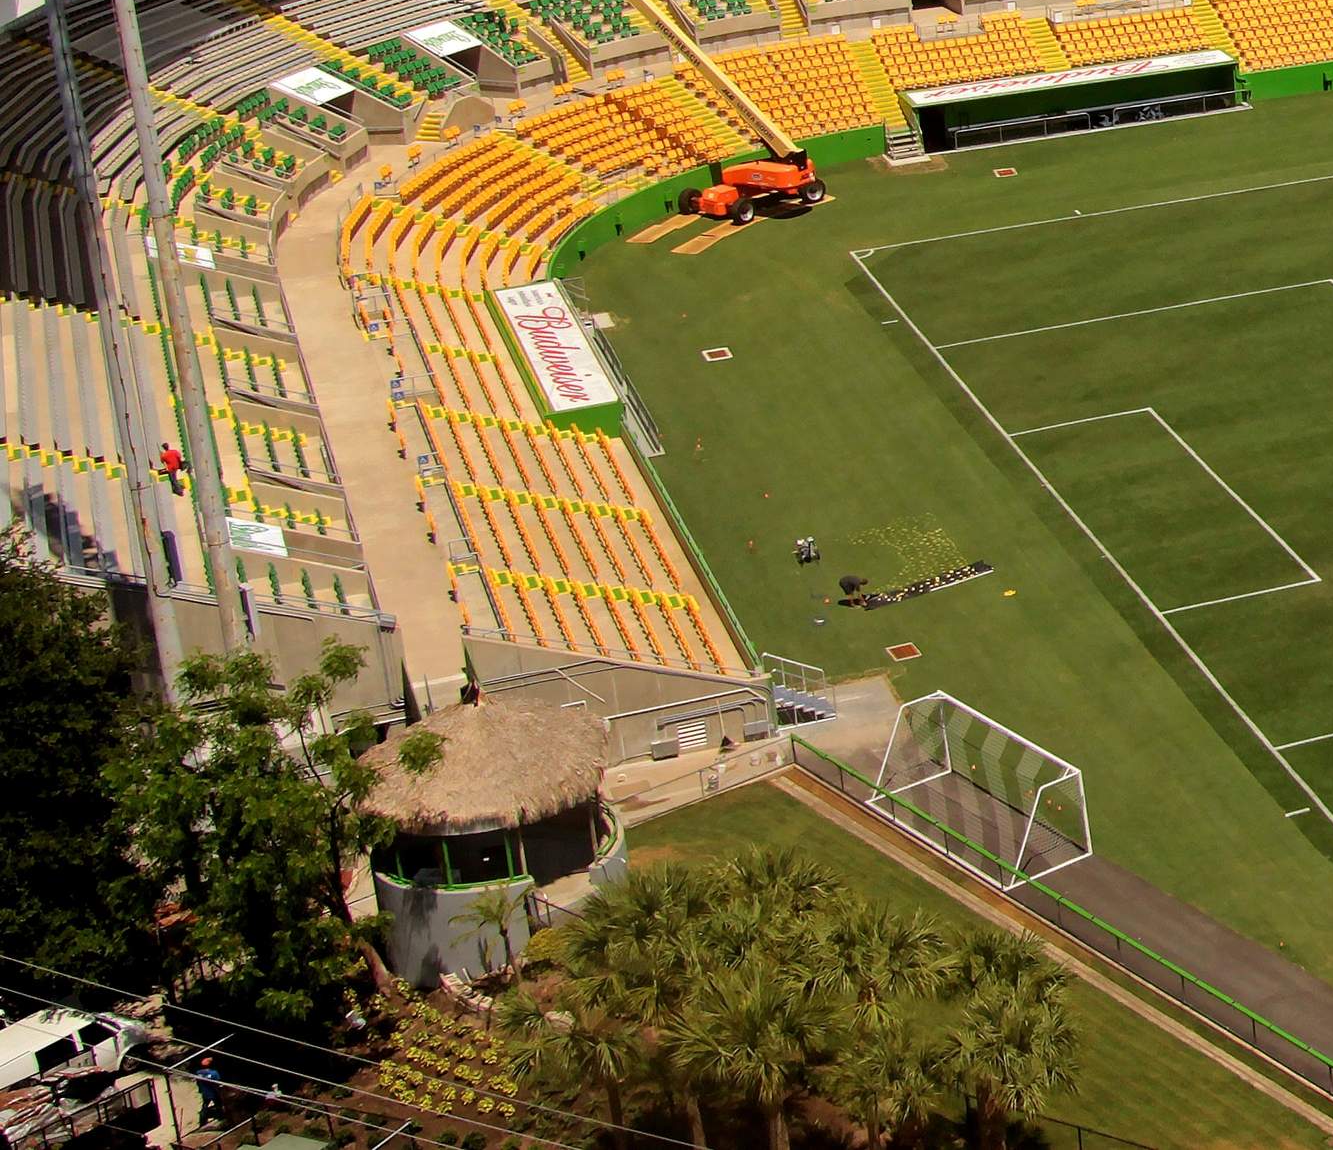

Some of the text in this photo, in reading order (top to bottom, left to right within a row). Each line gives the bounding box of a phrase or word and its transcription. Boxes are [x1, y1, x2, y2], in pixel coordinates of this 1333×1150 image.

[656, 20, 700, 66] HIGH REACH
[513, 306, 591, 403] Budweiser
